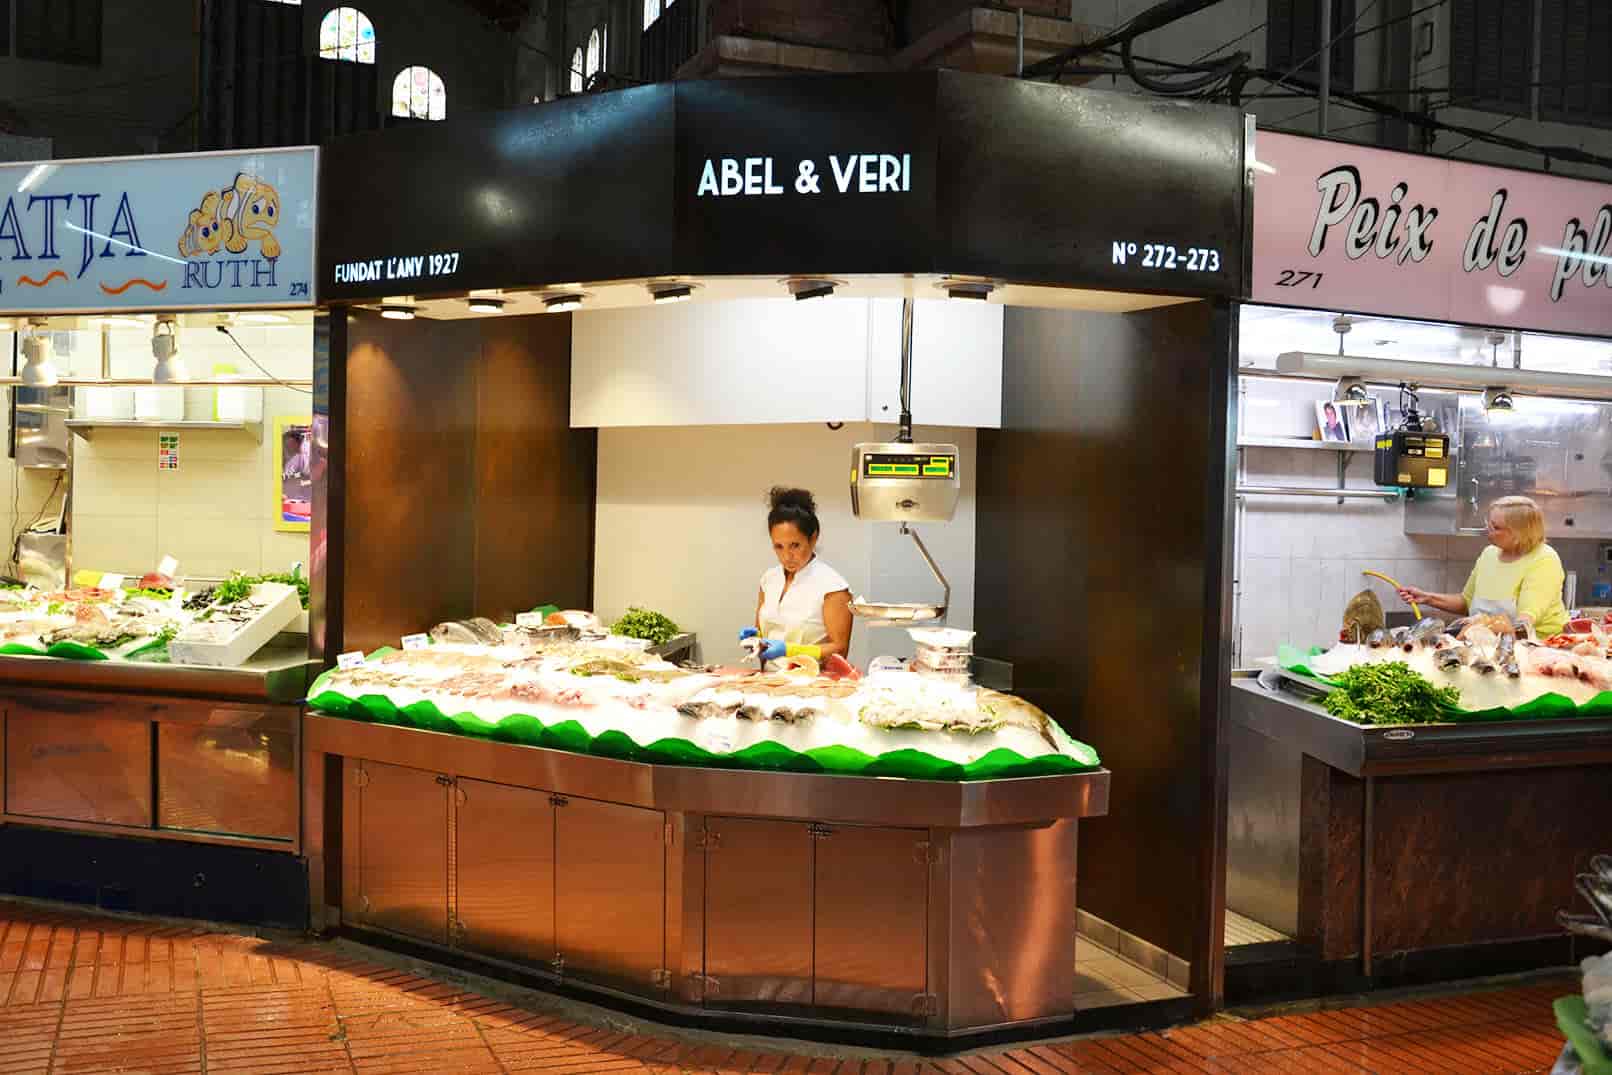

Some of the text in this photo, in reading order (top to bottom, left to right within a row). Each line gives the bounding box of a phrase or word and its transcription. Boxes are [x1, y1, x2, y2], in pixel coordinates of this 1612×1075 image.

[697, 153, 911, 196] ABEL & VERI
[1307, 165, 1612, 303] Peix de pl
[335, 253, 459, 283] FUNDAT L'ANY 1927
[1142, 244, 1220, 271] 272-273
[181, 257, 279, 289] RUTH
[1275, 270, 1323, 288] 271
[289, 283, 308, 296] 274
